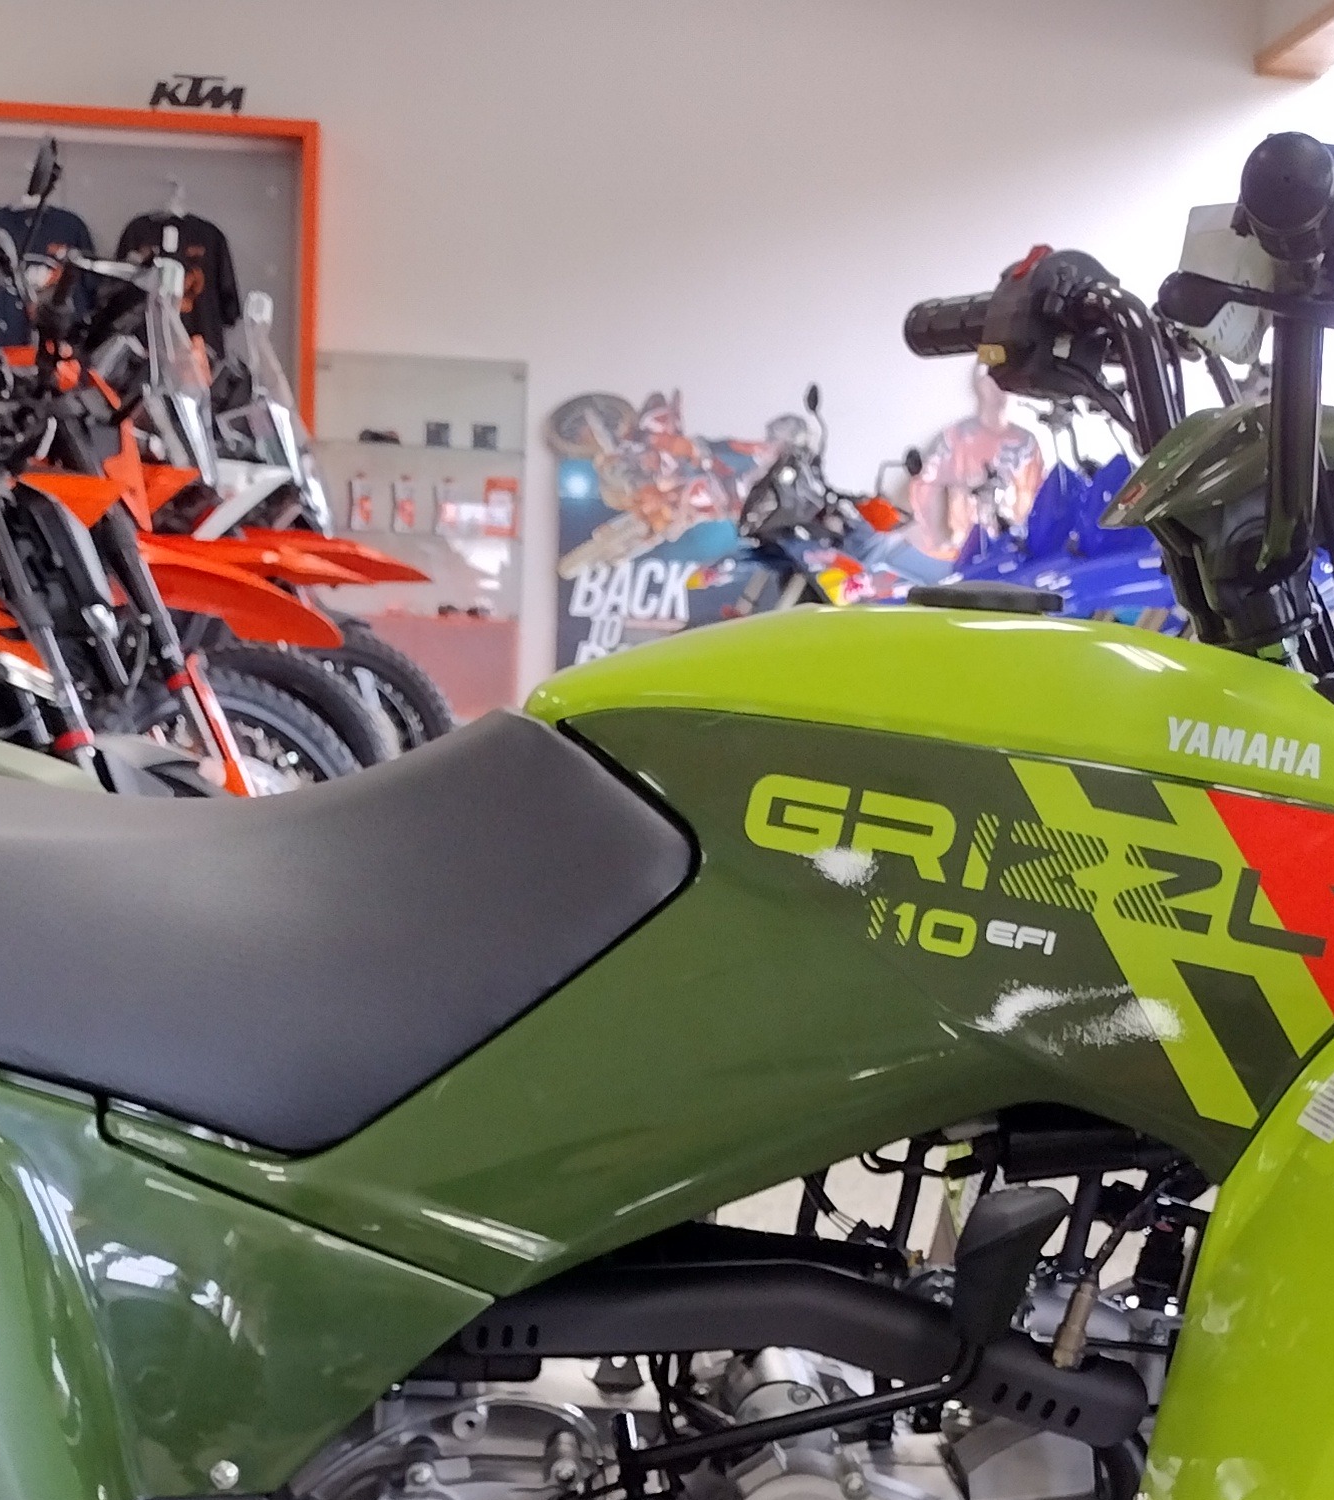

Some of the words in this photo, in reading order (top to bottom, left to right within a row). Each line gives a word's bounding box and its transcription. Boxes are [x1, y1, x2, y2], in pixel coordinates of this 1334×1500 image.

[149, 74, 245, 113] KTM
[569, 557, 690, 621] BACK
[589, 615, 623, 650] TO
[1168, 716, 1320, 779] YAMAHA
[868, 896, 977, 958] 110
[986, 919, 1058, 956] EFI
